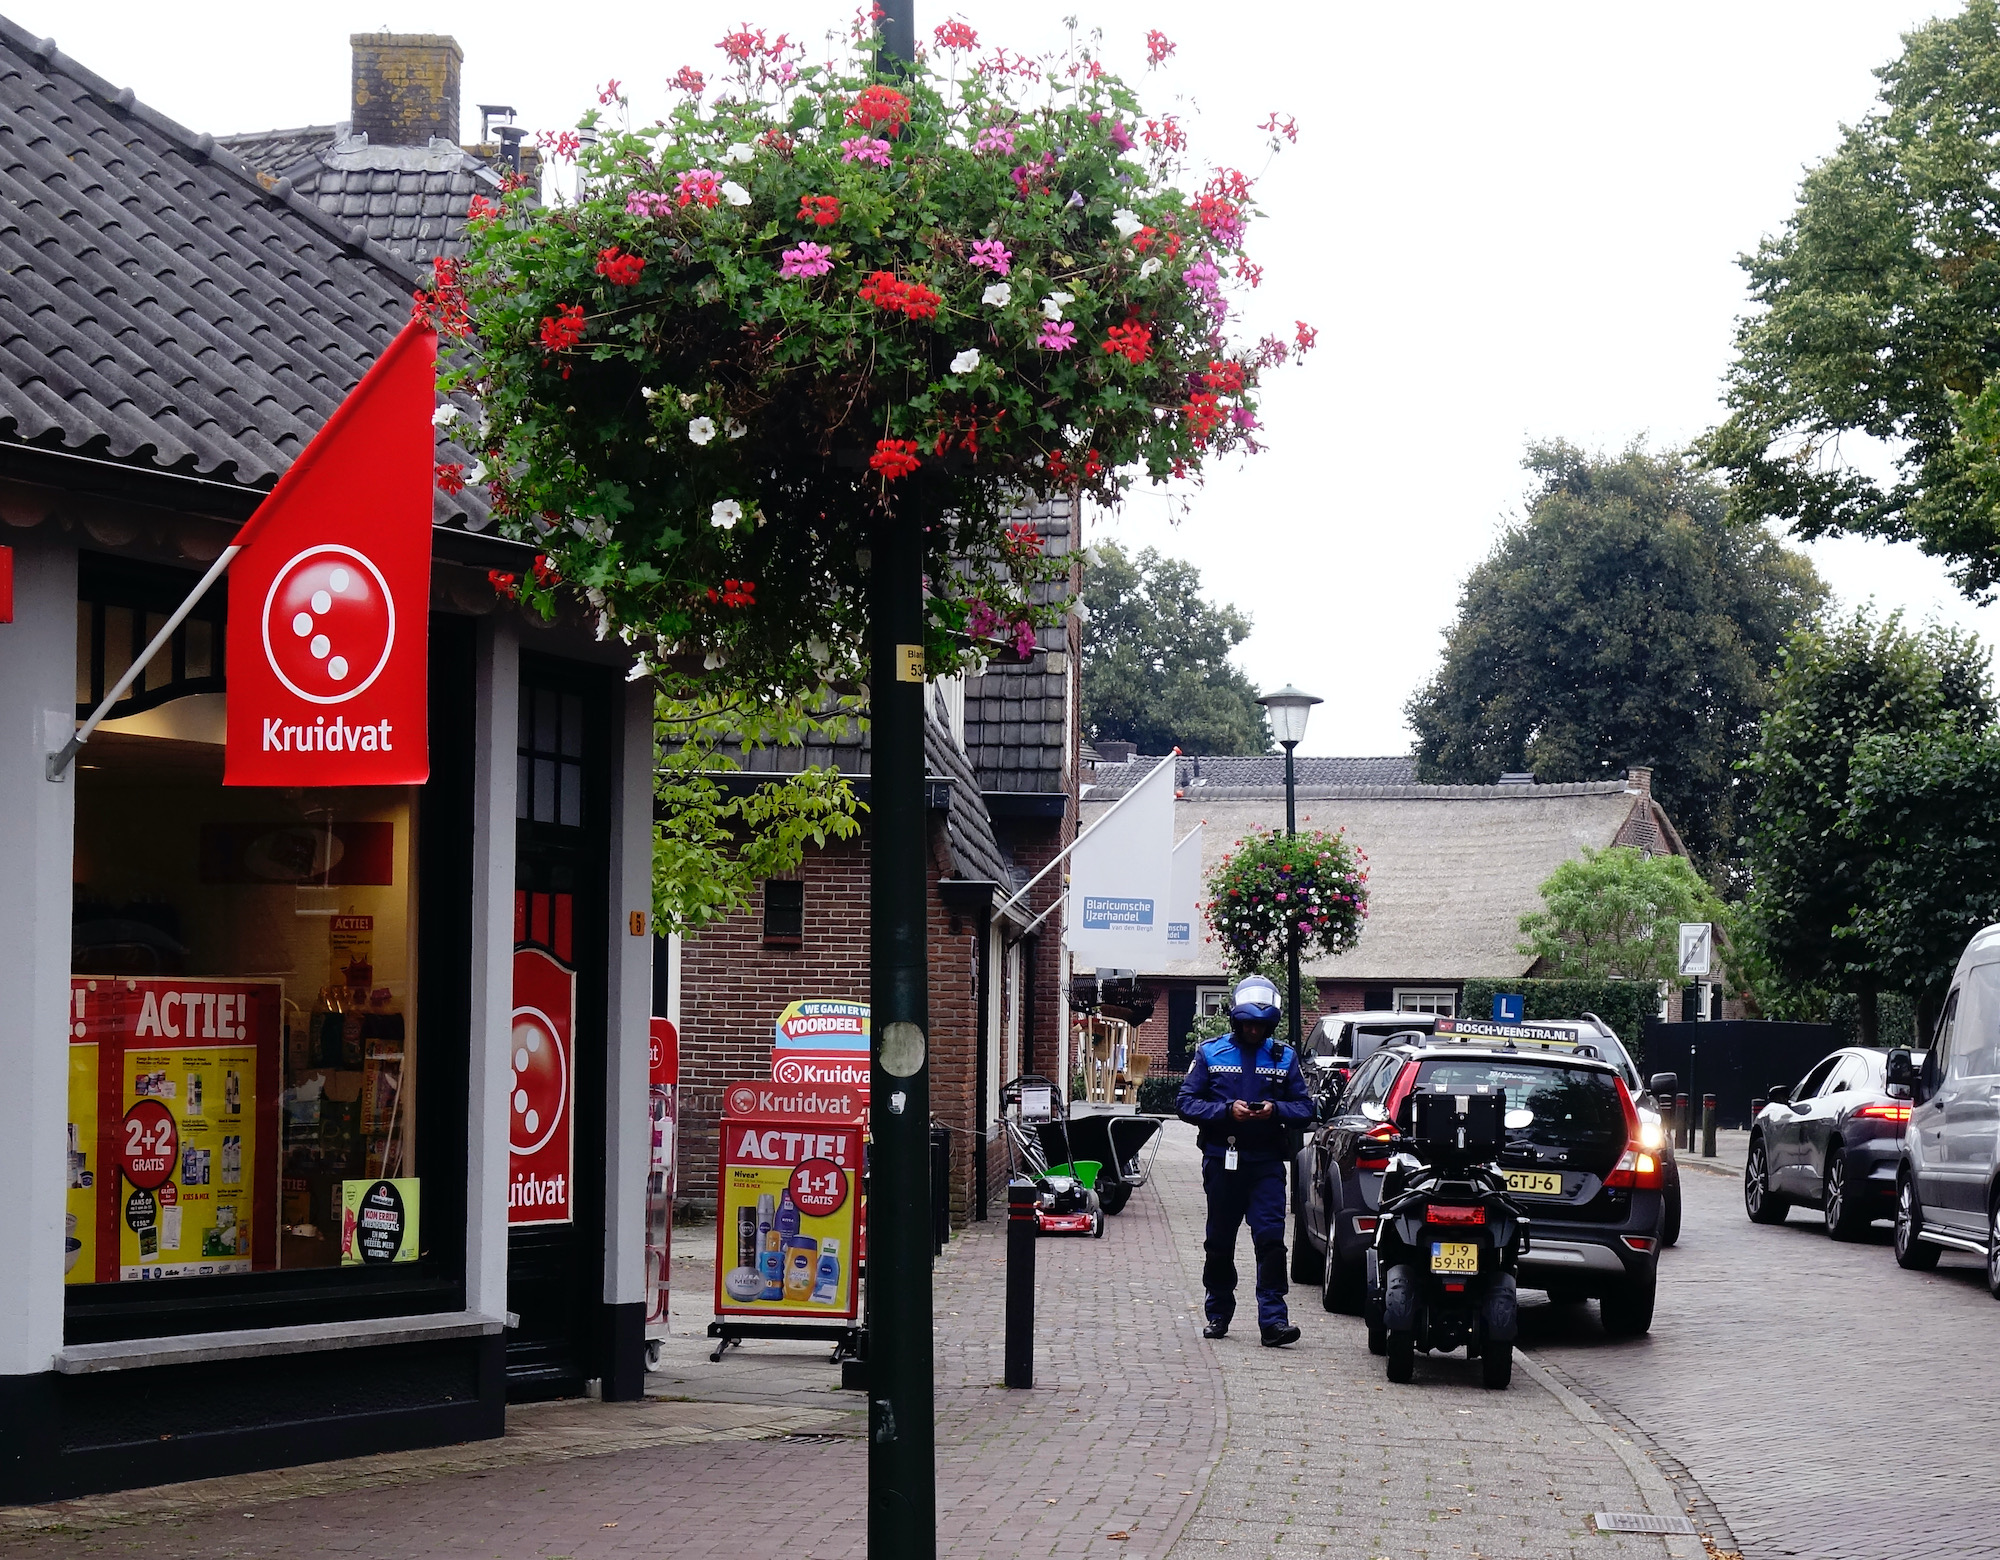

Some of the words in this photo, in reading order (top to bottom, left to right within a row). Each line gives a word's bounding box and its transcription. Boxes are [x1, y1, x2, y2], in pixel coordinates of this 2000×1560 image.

[263, 716, 392, 751] Kruidvat
[1086, 899, 1151, 911] Blaricumsche
[1086, 910, 1139, 922] IJzerhandel
[335, 918, 369, 929] ACTIE!
[804, 1004, 819, 1014] WE
[820, 1004, 846, 1014] GAAN
[847, 1005, 859, 1016] ER
[1500, 998, 1515, 1018] L
[135, 991, 246, 1040] ACTIE!
[1455, 1022, 1569, 1041] BOSCH-VEENSTRA.NL
[760, 1091, 851, 1114] Kruidvat
[125, 1118, 172, 1156] 2+2
[737, 1130, 847, 1166] ACTIE!
[132, 1158, 165, 1172] GRATIS
[797, 1170, 838, 1196] 1+1
[801, 1194, 833, 1206] GRATIS
[366, 1210, 378, 1220] KOM
[1449, 1245, 1469, 1256] J-9
[1434, 1258, 1475, 1269] 59-RP
